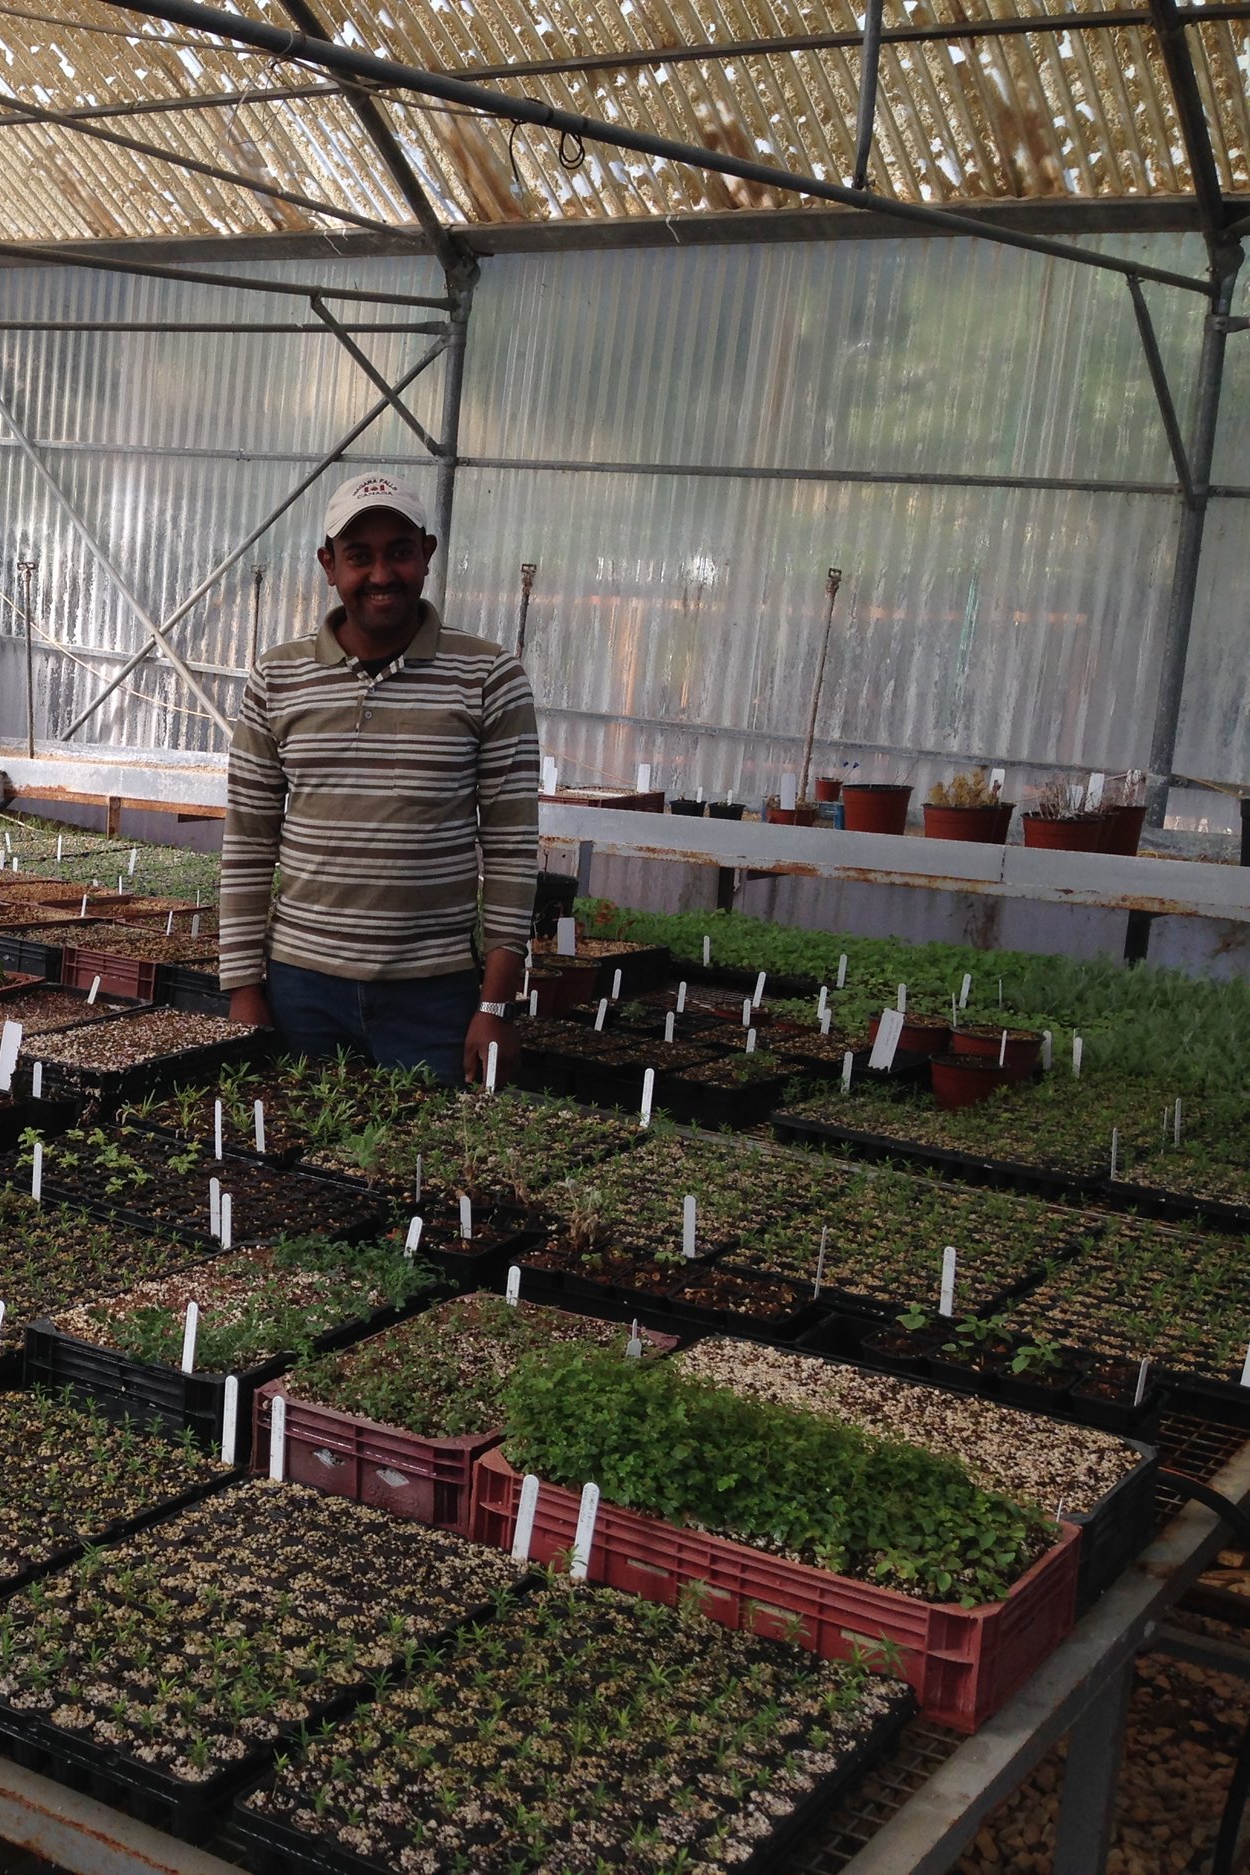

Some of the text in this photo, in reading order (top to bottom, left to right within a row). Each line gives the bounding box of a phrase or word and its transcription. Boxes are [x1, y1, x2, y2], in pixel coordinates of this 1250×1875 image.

[352, 478, 398, 496] NIAGARA FALLS
[357, 491, 393, 499] CANADA
